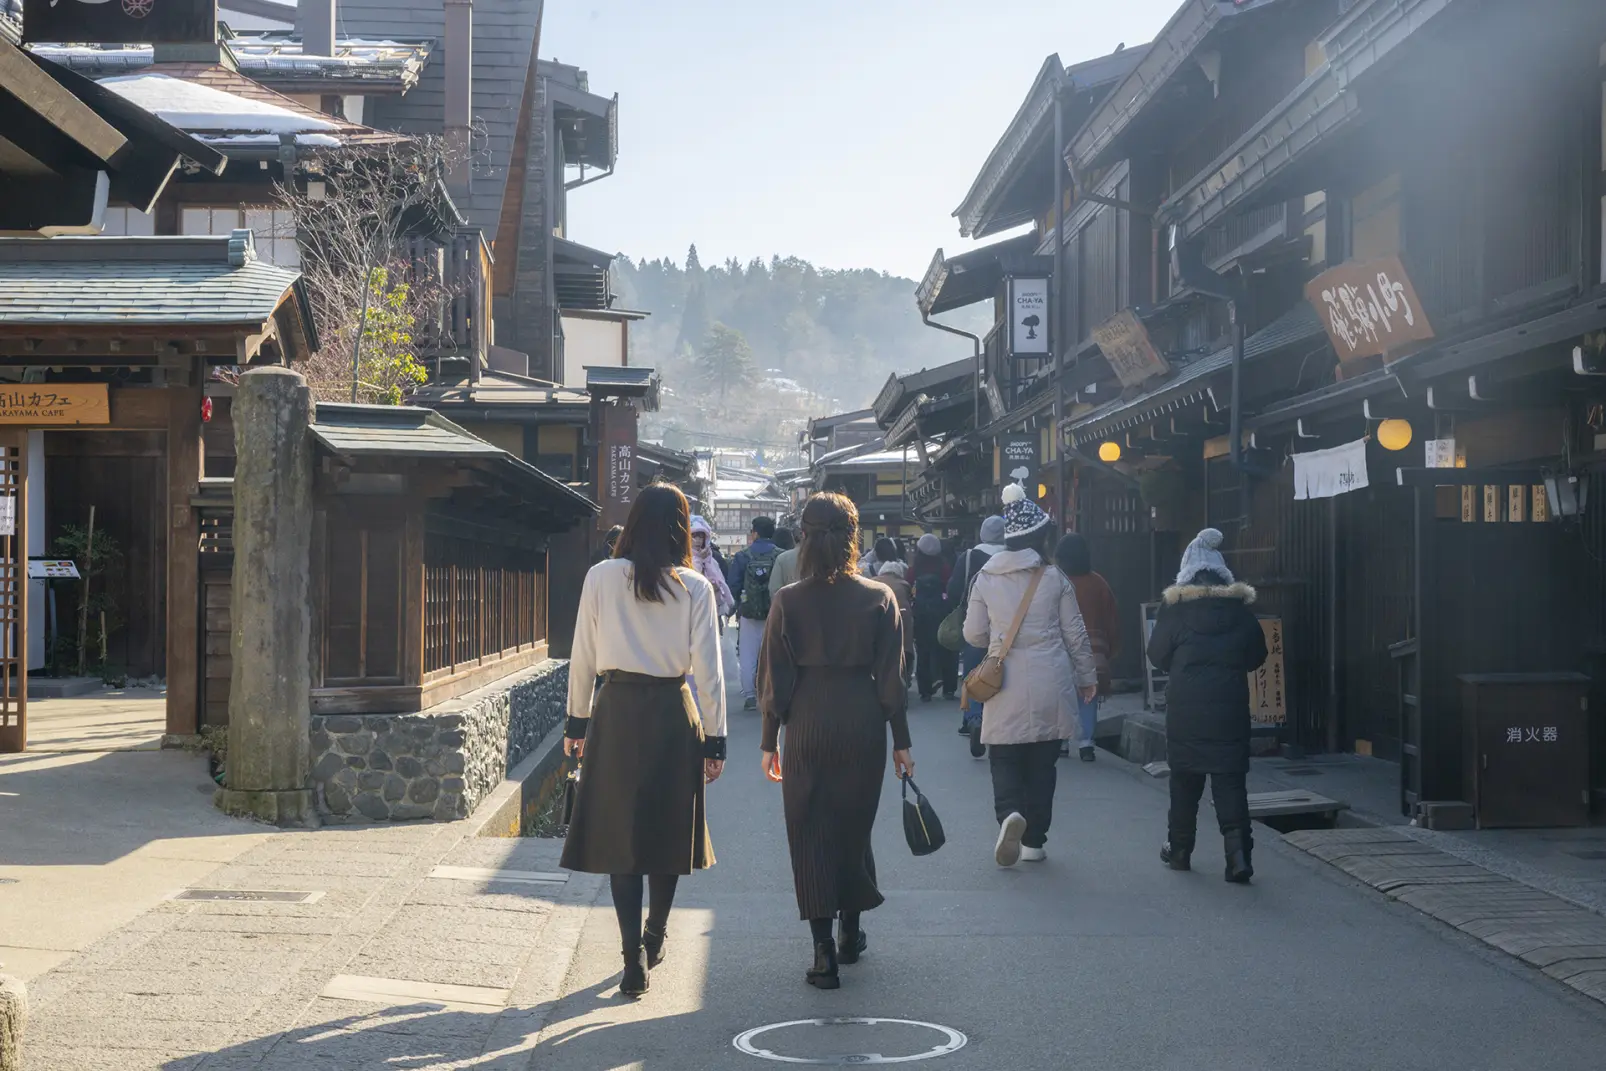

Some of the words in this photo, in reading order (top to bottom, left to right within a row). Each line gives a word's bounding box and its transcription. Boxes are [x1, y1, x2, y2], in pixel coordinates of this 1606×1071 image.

[619, 445, 631, 503] 高山カフェ
[1506, 726, 1558, 743] 消火器
